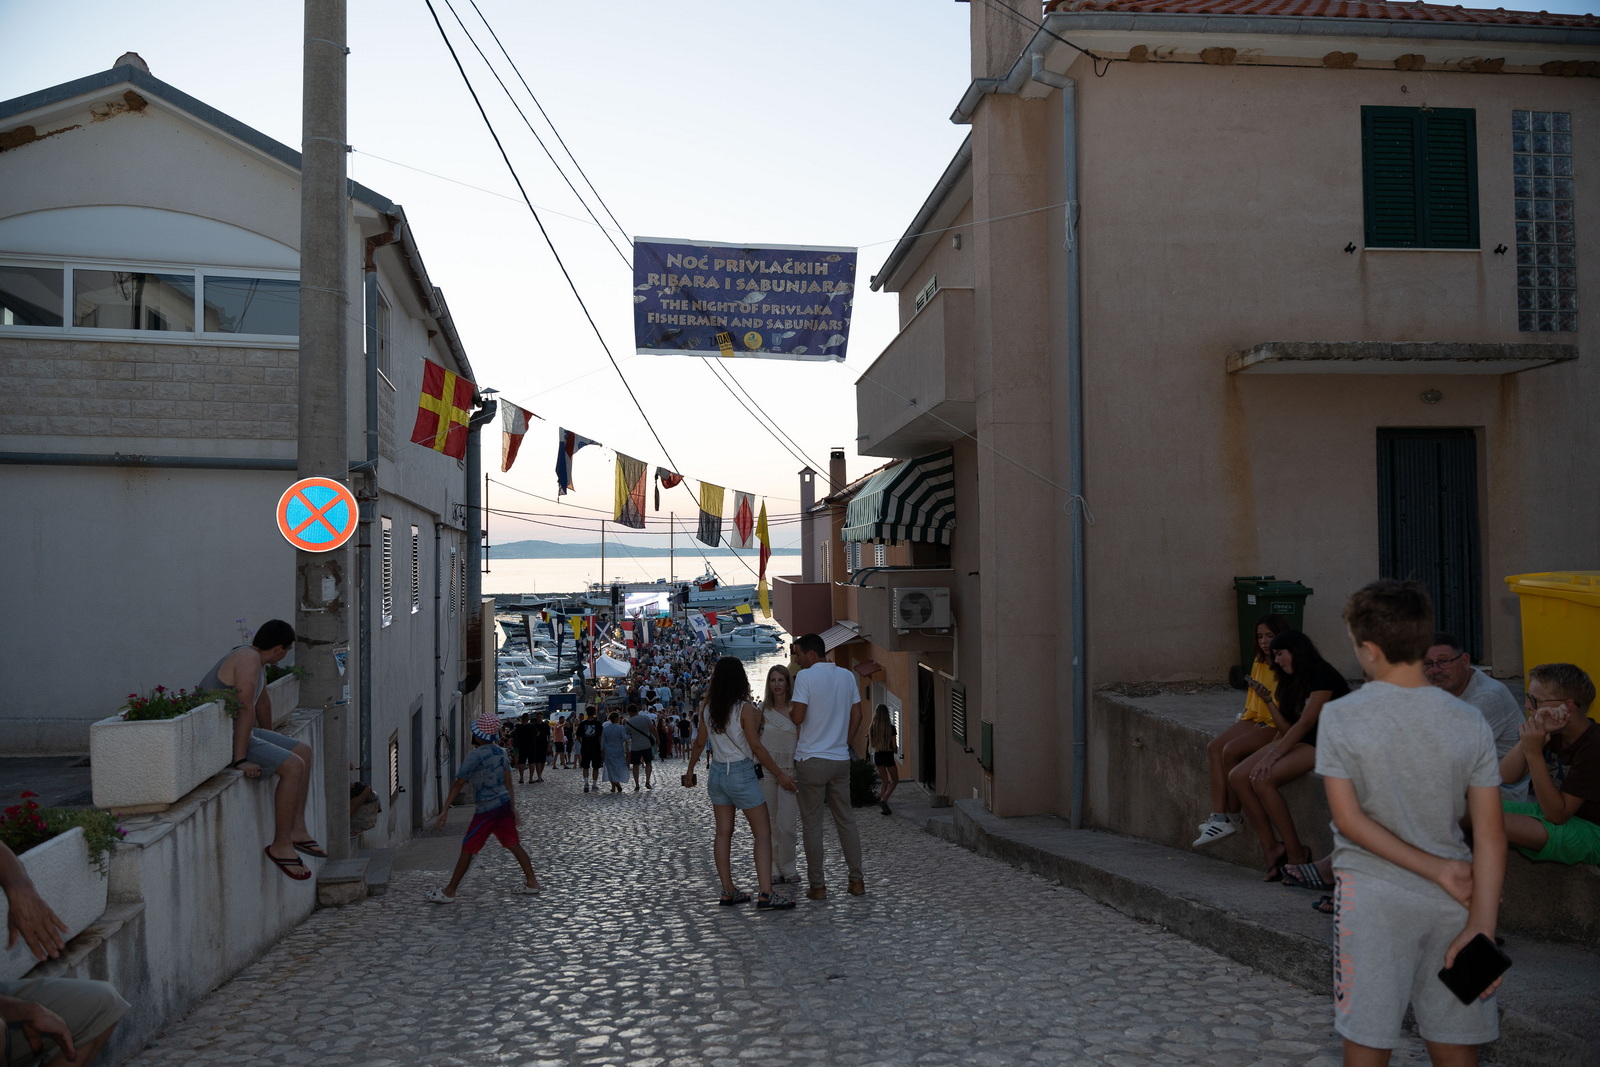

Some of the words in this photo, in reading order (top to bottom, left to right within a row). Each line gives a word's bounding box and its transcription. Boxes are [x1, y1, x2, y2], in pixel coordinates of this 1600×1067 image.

[666, 253, 709, 270] NOĆ
[713, 257, 829, 276] PRIVLAČKIH
[647, 272, 720, 290] RIBARA
[725, 277, 731, 290] I
[735, 278, 848, 295] SABUNJARA
[660, 298, 689, 311] THE
[691, 300, 737, 313] NIGHT
[739, 303, 759, 314] OF
[762, 304, 833, 316] PRIVLAKA
[647, 312, 728, 327] FISHERMEN
[730, 316, 764, 329] AND
[766, 318, 843, 331] SABUNJARS
